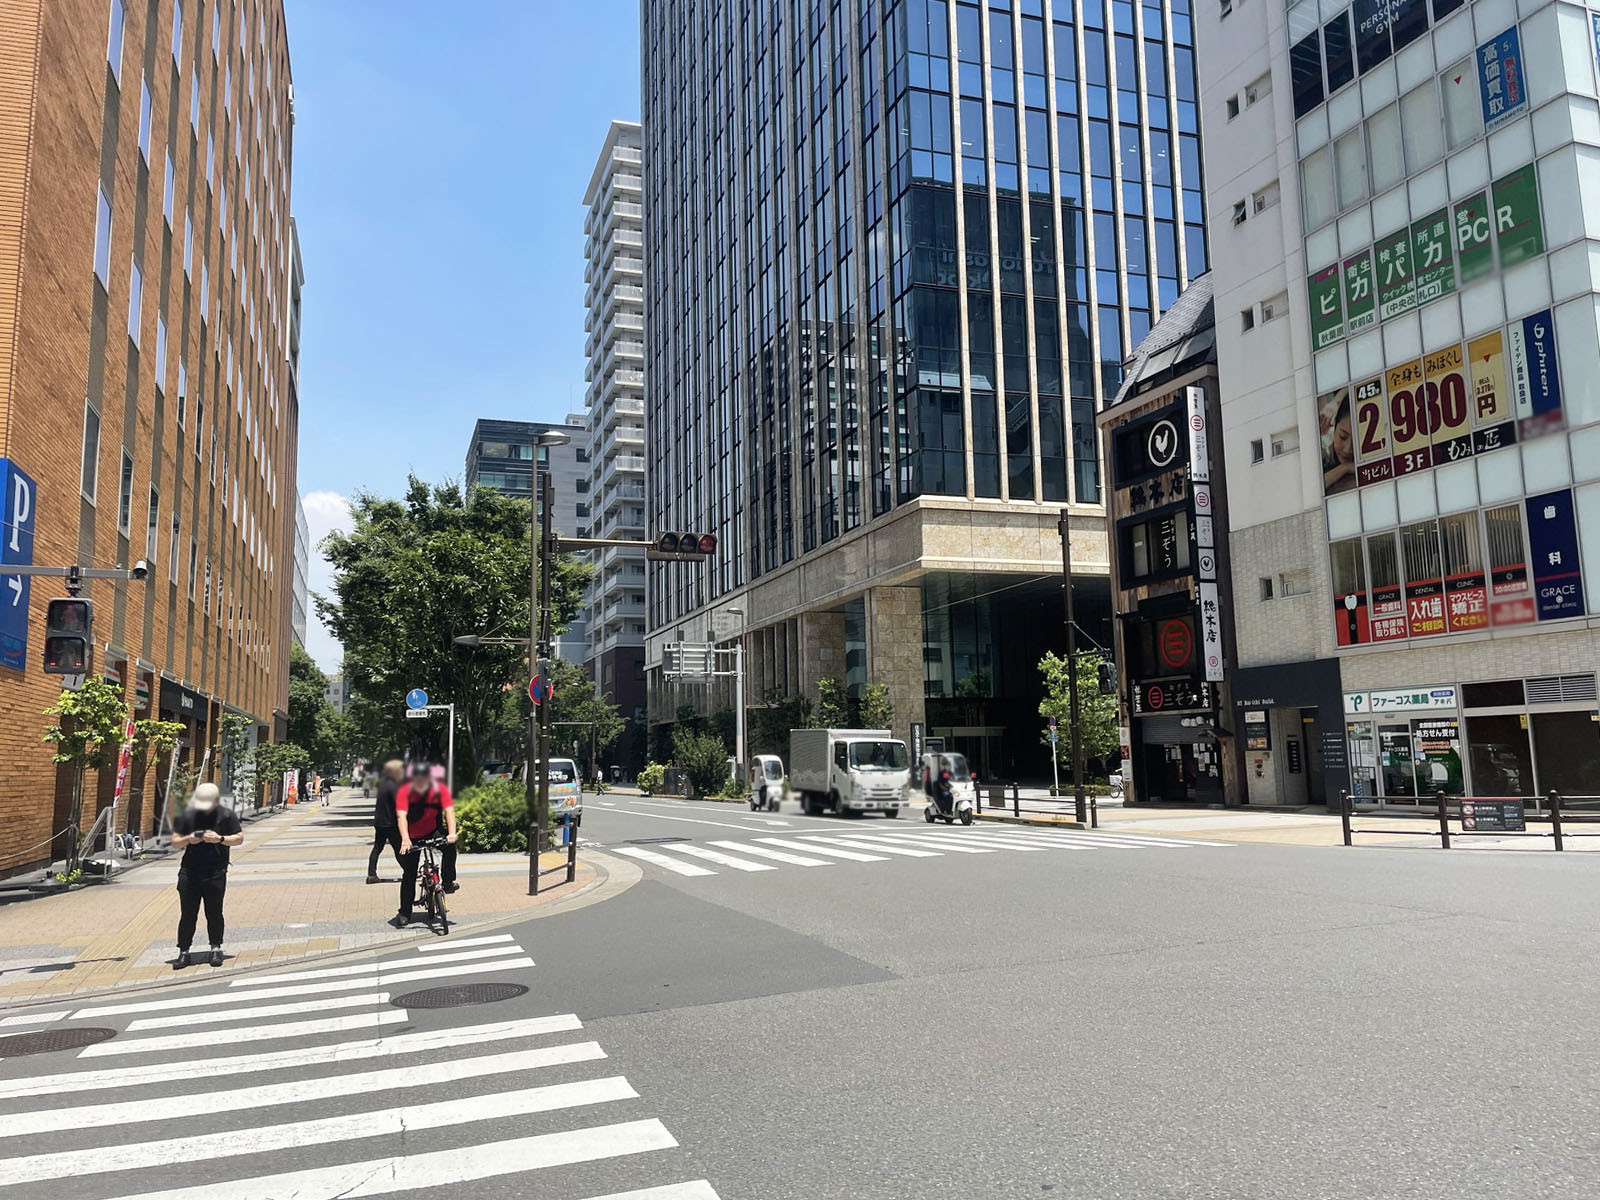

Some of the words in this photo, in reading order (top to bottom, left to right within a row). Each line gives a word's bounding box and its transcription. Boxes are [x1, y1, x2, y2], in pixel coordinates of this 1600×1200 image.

[1375, 11, 1400, 34] GYM
[1482, 42, 1505, 116] 高価買取
[1321, 312, 1375, 344] 秋葉原駅前店
[1390, 350, 1462, 387] 全身もみほぐし
[1534, 341, 1549, 397] phiten
[1404, 453, 1424, 473] 3F
[10, 472, 30, 553] P
[1414, 586, 1436, 596] DENTAL
[1455, 579, 1476, 589] CLINIC
[1448, 589, 1486, 604] マウスピース
[1540, 584, 1576, 598] GRACE
[1410, 597, 1443, 621] 入れ歯
[1451, 599, 1485, 616] 矯正
[1202, 599, 1218, 643] 総本店
[1412, 620, 1445, 633] ご相談
[1452, 613, 1487, 627] ください
[1372, 693, 1430, 707] ファーコス薬局
[1415, 729, 1456, 738] 処方せん受付
